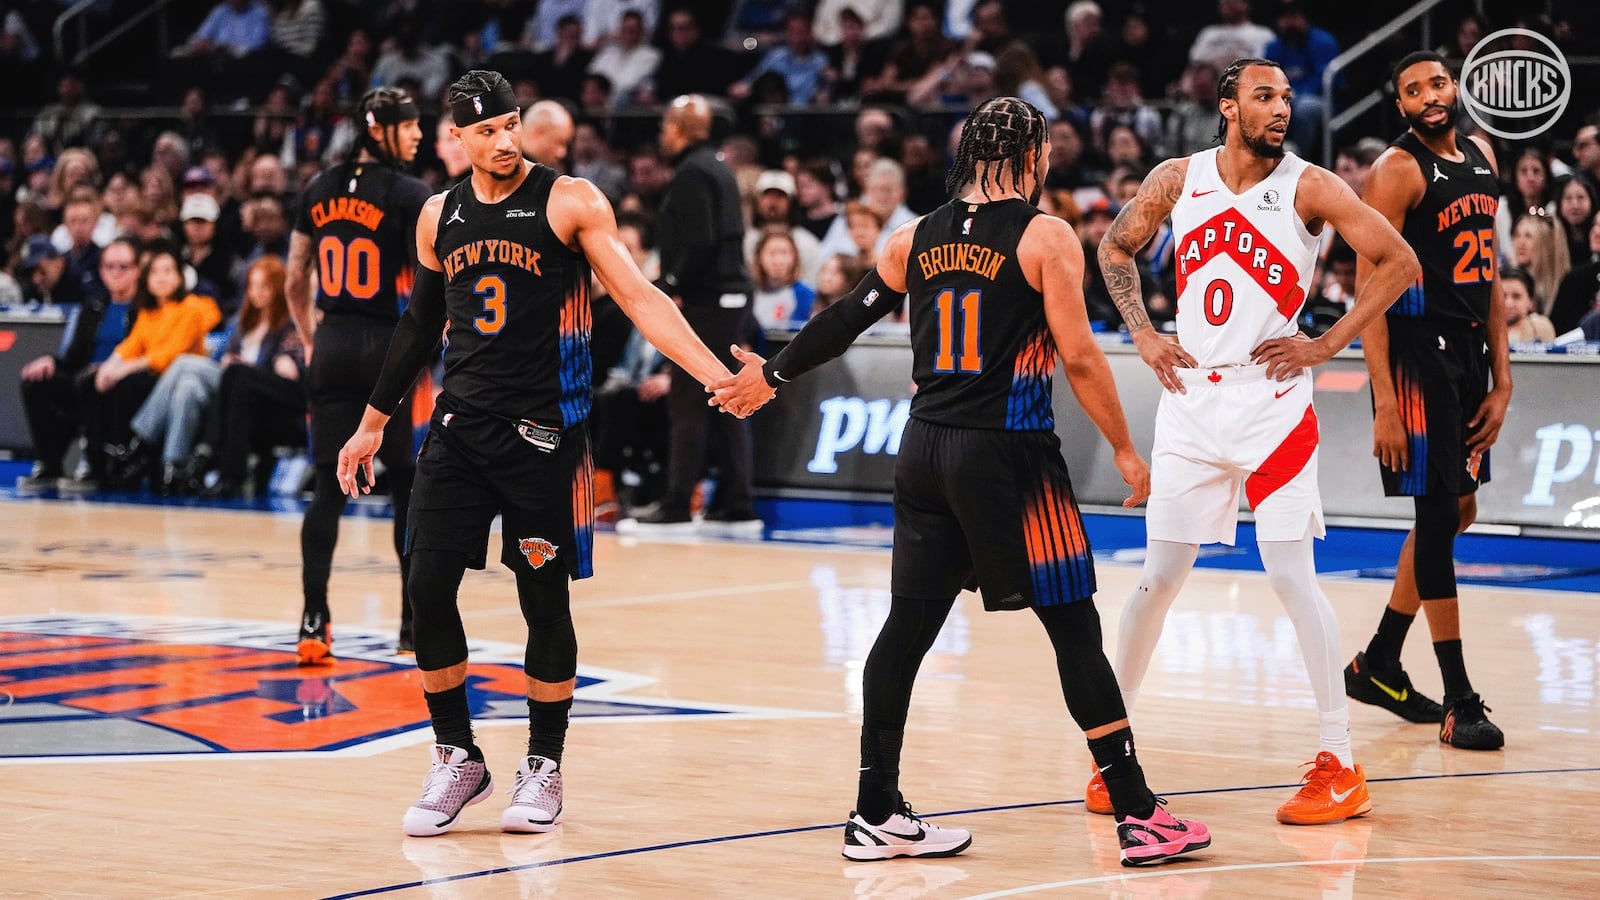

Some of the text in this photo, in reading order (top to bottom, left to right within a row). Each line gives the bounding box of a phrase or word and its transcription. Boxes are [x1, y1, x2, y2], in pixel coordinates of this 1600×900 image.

[311, 196, 384, 231] CLARKSON
[1437, 193, 1498, 232] NEW YOR
[319, 235, 381, 299] 00
[443, 239, 542, 283] NEW YORK
[918, 243, 1006, 281] BRUNSON
[1180, 221, 1283, 285] RAPTORS
[1453, 228, 1494, 284] 25
[473, 274, 508, 336] 3
[1204, 278, 1234, 327] 0
[933, 288, 984, 375] 11
